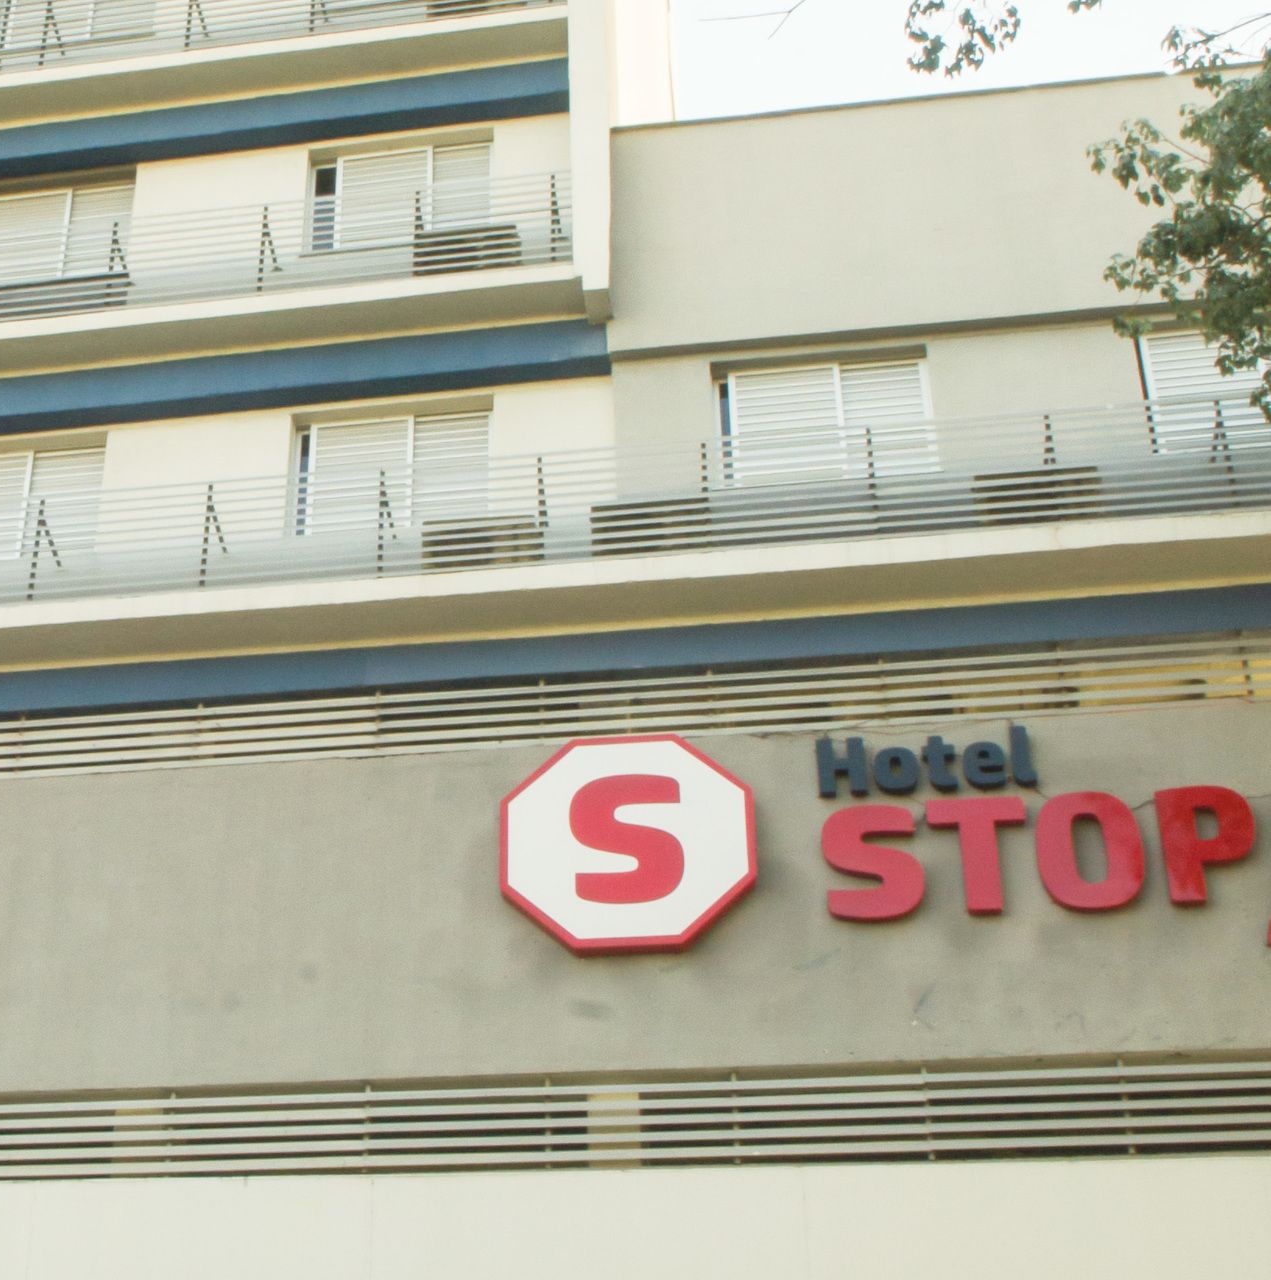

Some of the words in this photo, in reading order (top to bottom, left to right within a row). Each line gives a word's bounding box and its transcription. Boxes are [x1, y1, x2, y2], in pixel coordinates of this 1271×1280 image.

[816, 724, 1038, 798] Hotel
[569, 773, 685, 904] S
[821, 785, 1256, 920] STOP
